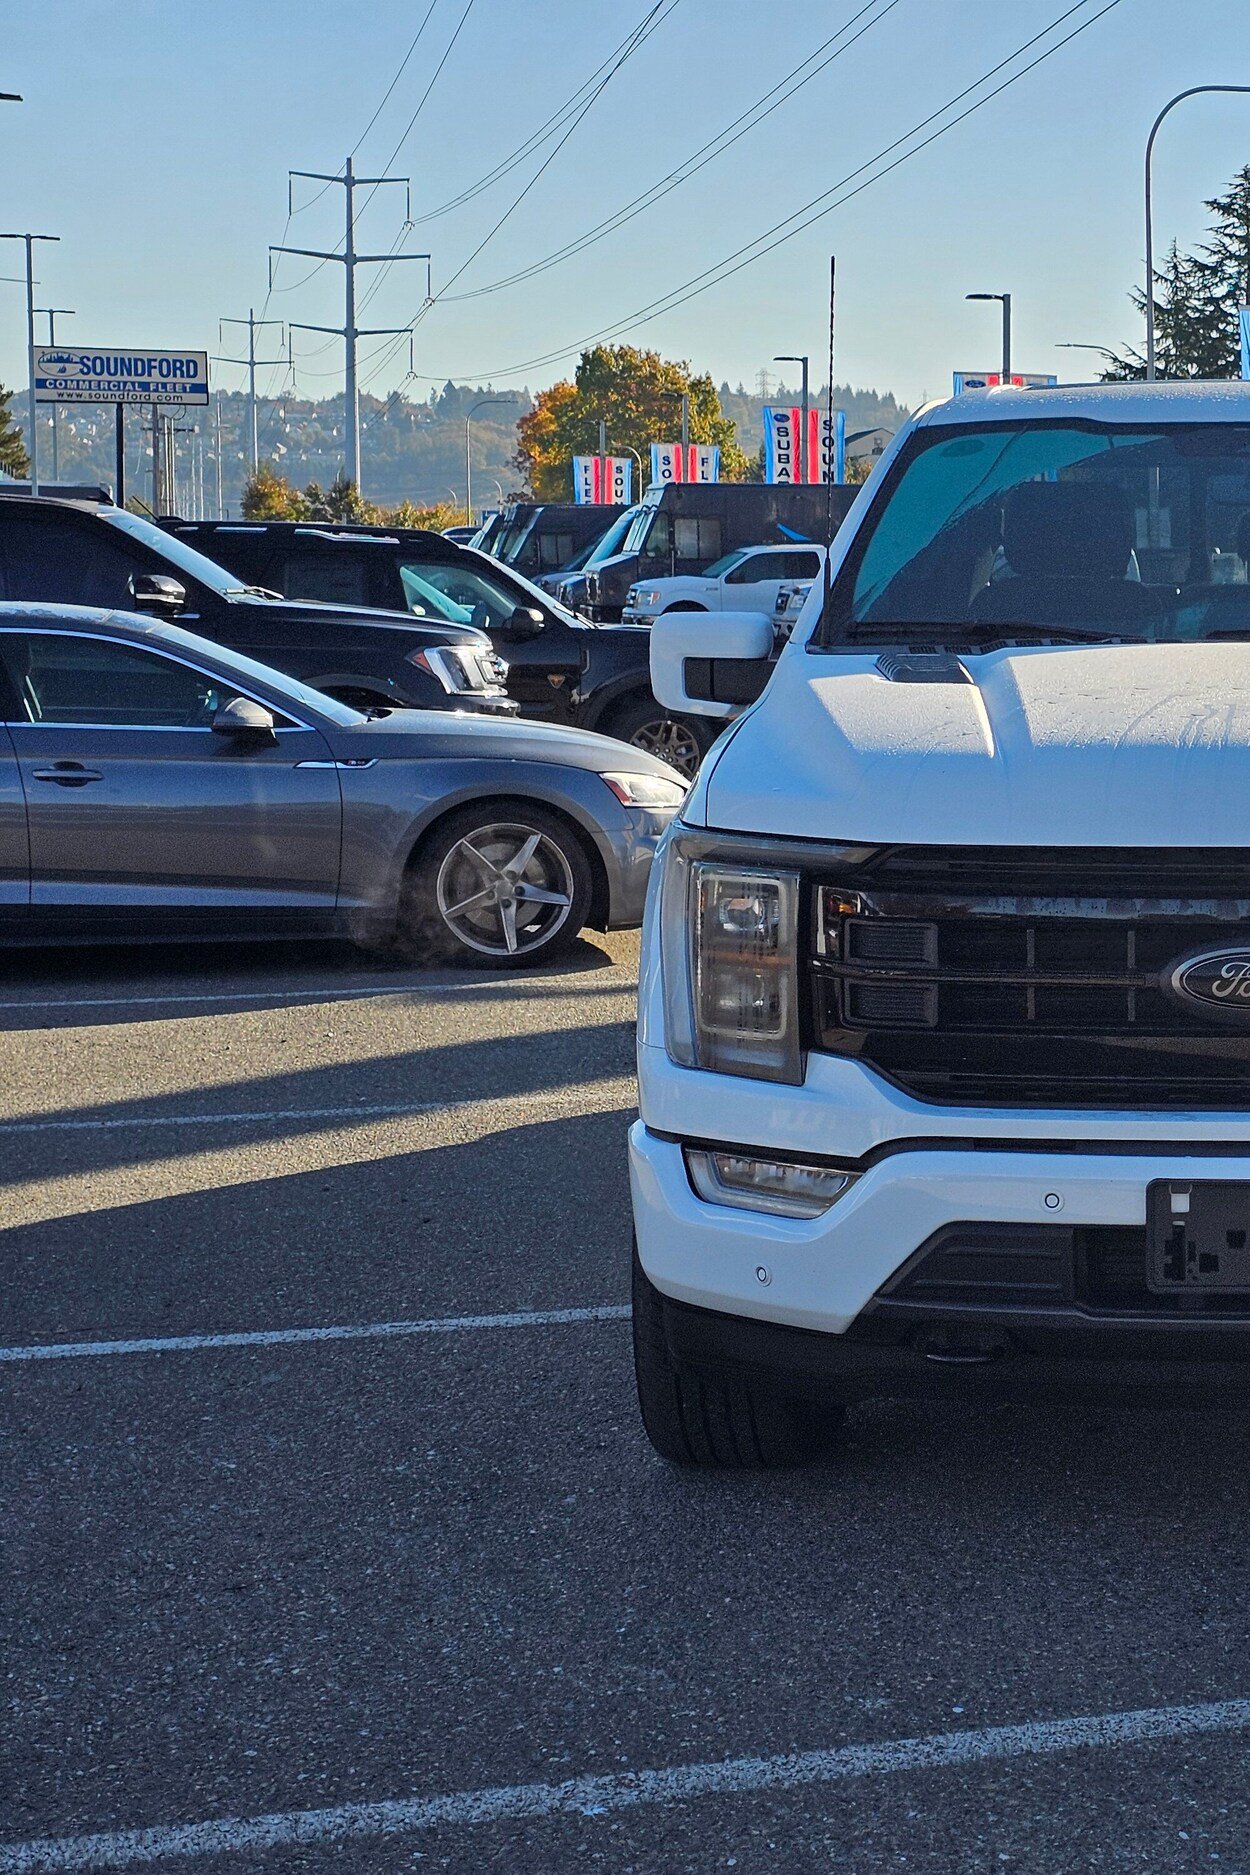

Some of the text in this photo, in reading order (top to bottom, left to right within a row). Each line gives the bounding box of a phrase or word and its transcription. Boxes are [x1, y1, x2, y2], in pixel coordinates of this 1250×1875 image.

[79, 355, 198, 379] SOUNDFORD
[45, 378, 192, 392] COMMERCIAL FLEET
[56, 390, 183, 402] www.soundford.com
